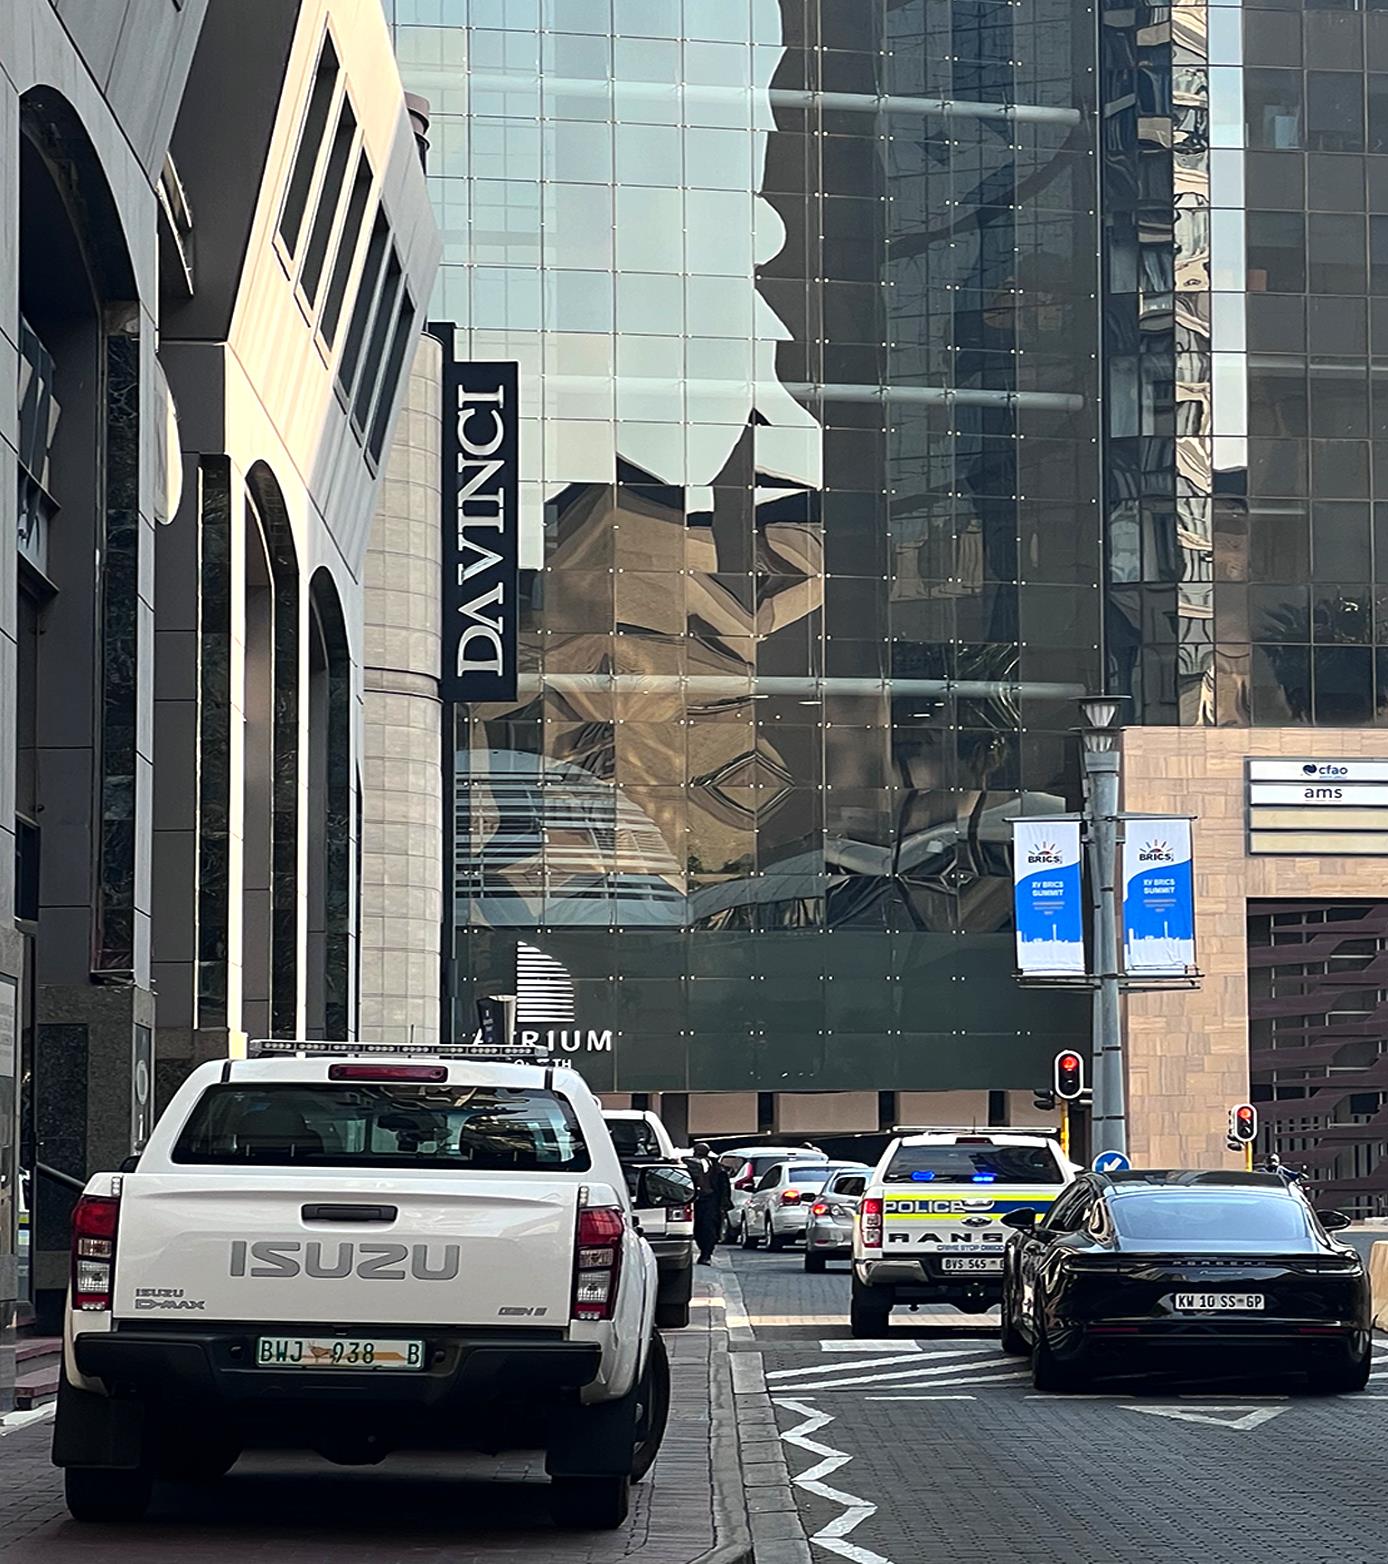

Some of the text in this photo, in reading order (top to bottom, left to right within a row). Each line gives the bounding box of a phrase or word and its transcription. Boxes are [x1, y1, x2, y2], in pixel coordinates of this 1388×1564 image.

[1318, 764, 1348, 775] cfao
[1304, 788, 1343, 799] ams
[1028, 855, 1060, 864] BRICS
[1139, 853, 1172, 862] BRICS
[472, 1028, 613, 1052] RIUM
[885, 1201, 965, 1213] POLICE
[888, 1233, 1003, 1243] RANG
[229, 1240, 460, 1281] ISUZU
[1178, 1295, 1194, 1308] KW
[1246, 1295, 1262, 1308] GP
[261, 1340, 303, 1362] BWJ
[407, 1344, 419, 1365] B
